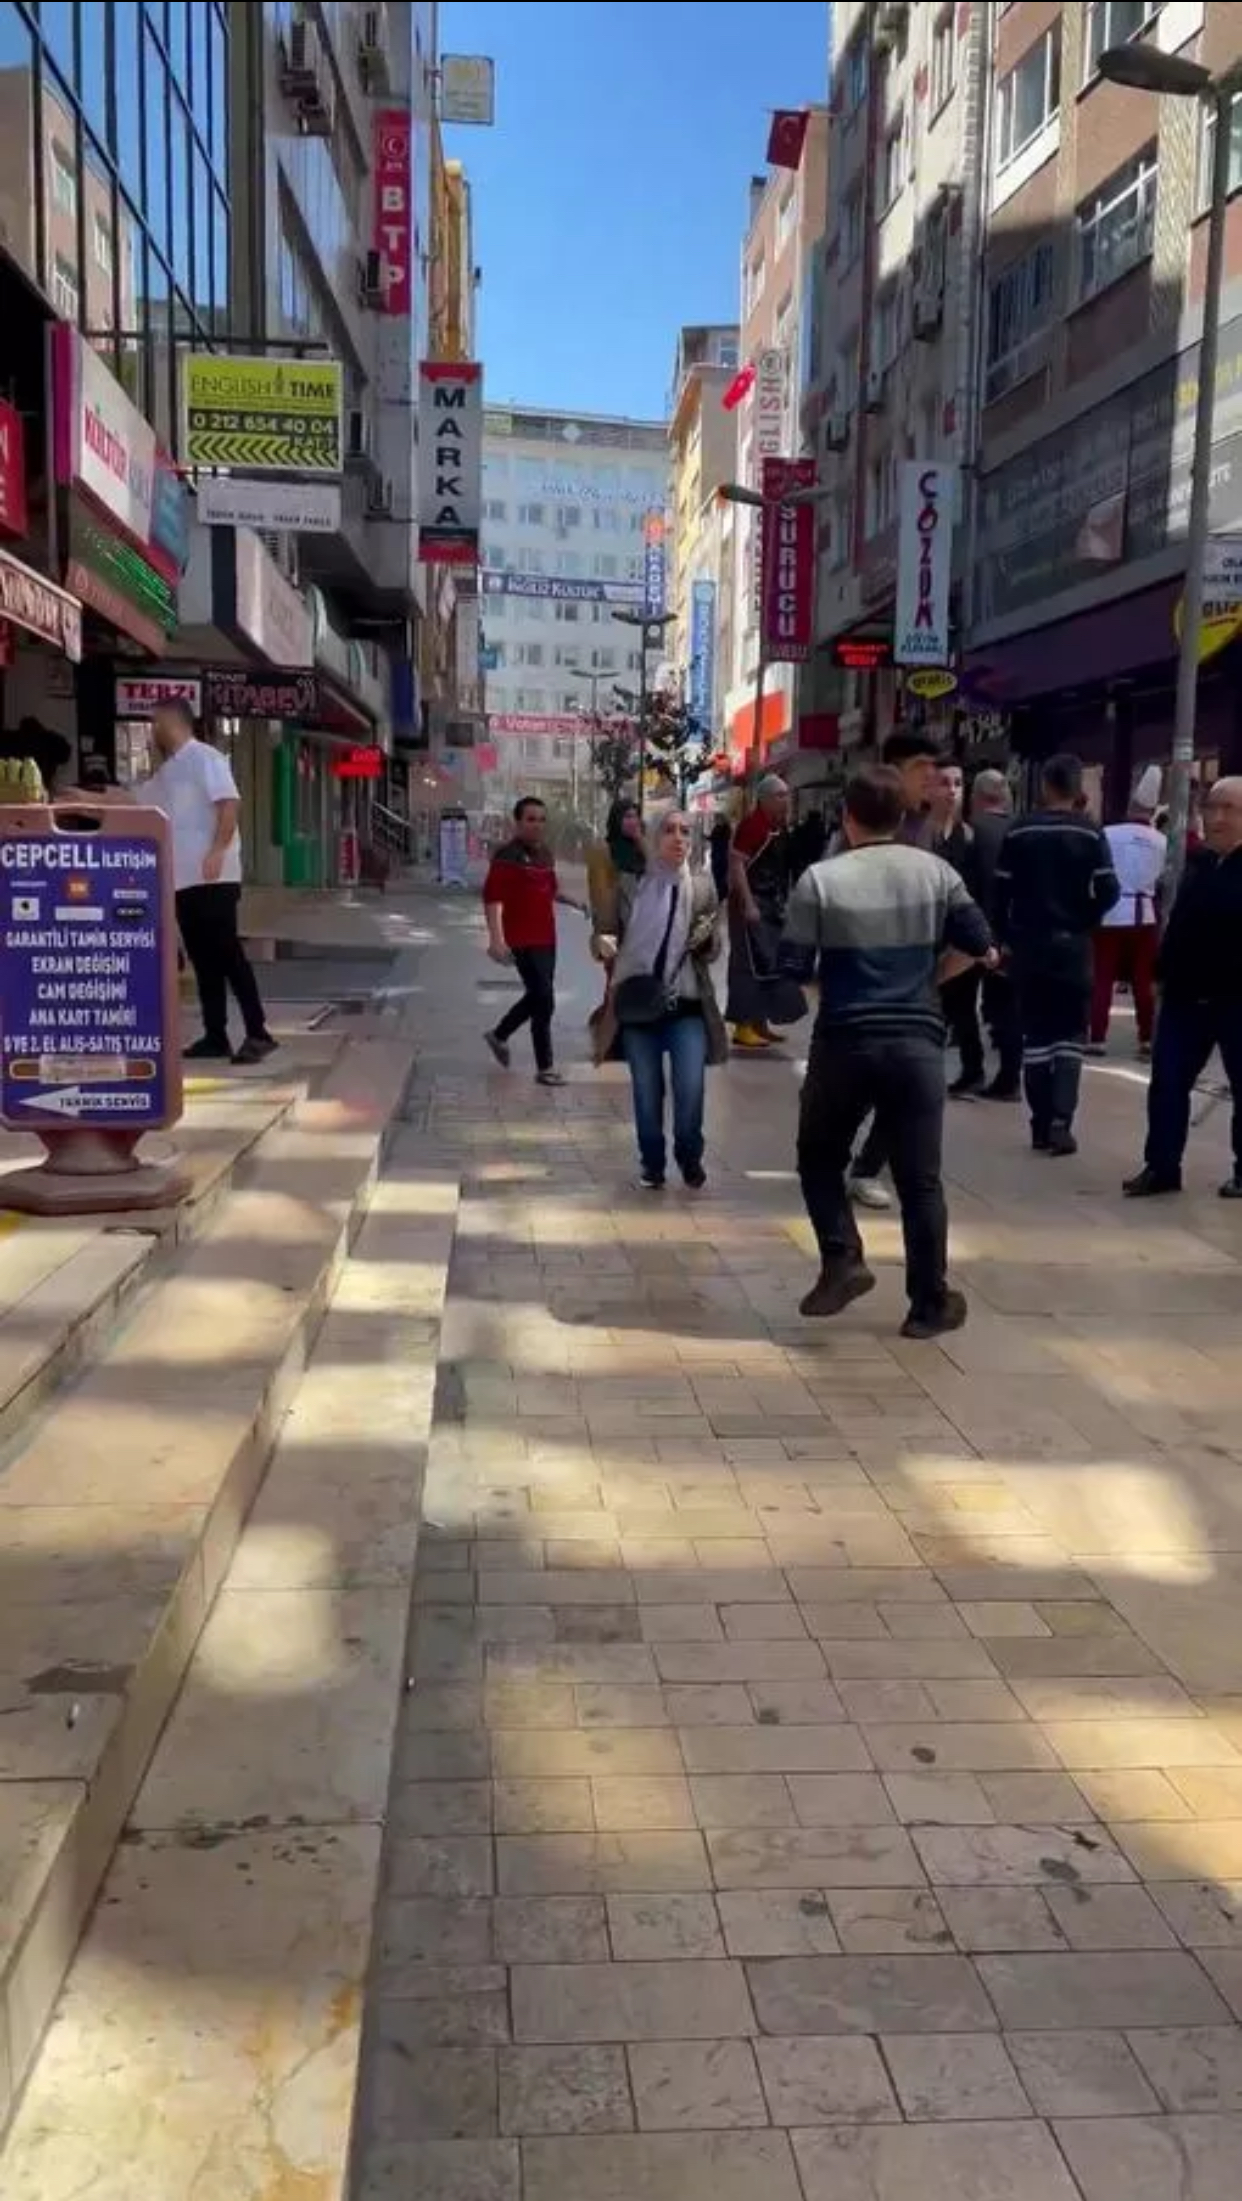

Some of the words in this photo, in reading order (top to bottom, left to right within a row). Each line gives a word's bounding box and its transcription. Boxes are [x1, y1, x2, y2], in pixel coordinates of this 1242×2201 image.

[380, 185, 406, 309] BTP
[192, 376, 272, 394] ENGLISH
[290, 381, 337, 398] TIME
[194, 413, 206, 428] 0
[210, 413, 239, 430] 212
[283, 420, 306, 433] 40
[310, 421, 334, 434] 04
[433, 385, 467, 526] MARKA
[1, 844, 100, 868] CEPCELL
[101, 850, 157, 869] İLETİŞİM
[6, 926, 68, 948] GARANTİLİ
[70, 928, 107, 948] TAMİR
[109, 928, 155, 948] SERVİSİ
[31, 956, 74, 973] EKRAN
[76, 953, 130, 974] DEĞİŞİMİ
[37, 983, 66, 1000] CAM
[68, 978, 127, 1001] DEĞİŞİMİ
[29, 1009, 56, 1025] ANA
[58, 1009, 91, 1025] KART
[93, 1005, 137, 1026] TAMİRİ
[12, 1035, 28, 1052] VE
[42, 1035, 57, 1052] EL
[123, 1036, 161, 1051] TAKAS
